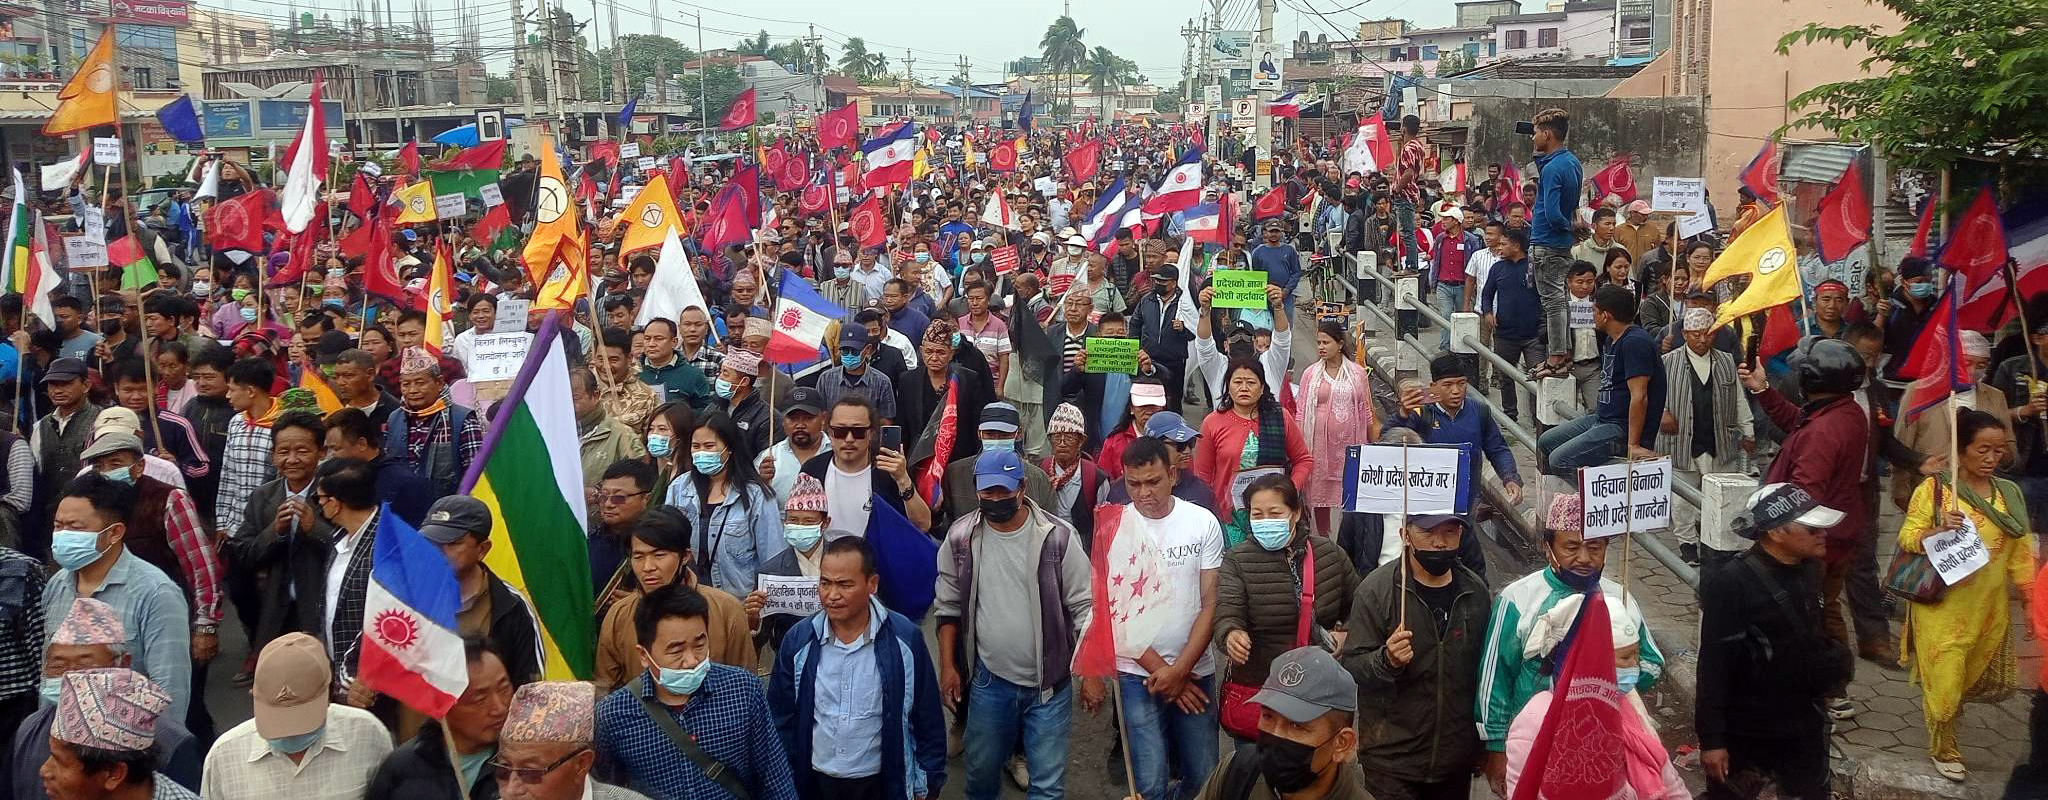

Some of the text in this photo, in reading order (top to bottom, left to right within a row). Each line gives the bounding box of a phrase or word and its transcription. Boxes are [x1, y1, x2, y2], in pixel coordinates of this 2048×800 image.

[1361, 465, 1384, 486] कोशी
[1408, 467, 1434, 488] खारेज
[1436, 473, 1449, 488] गर
[1592, 467, 1664, 498] पहिचान बिनाको
[1587, 504, 1609, 527] कोशी
[1765, 495, 1793, 519] कोशी
[1166, 543, 1201, 559] KING
[1937, 546, 1977, 574] कोशी प्रदेश
